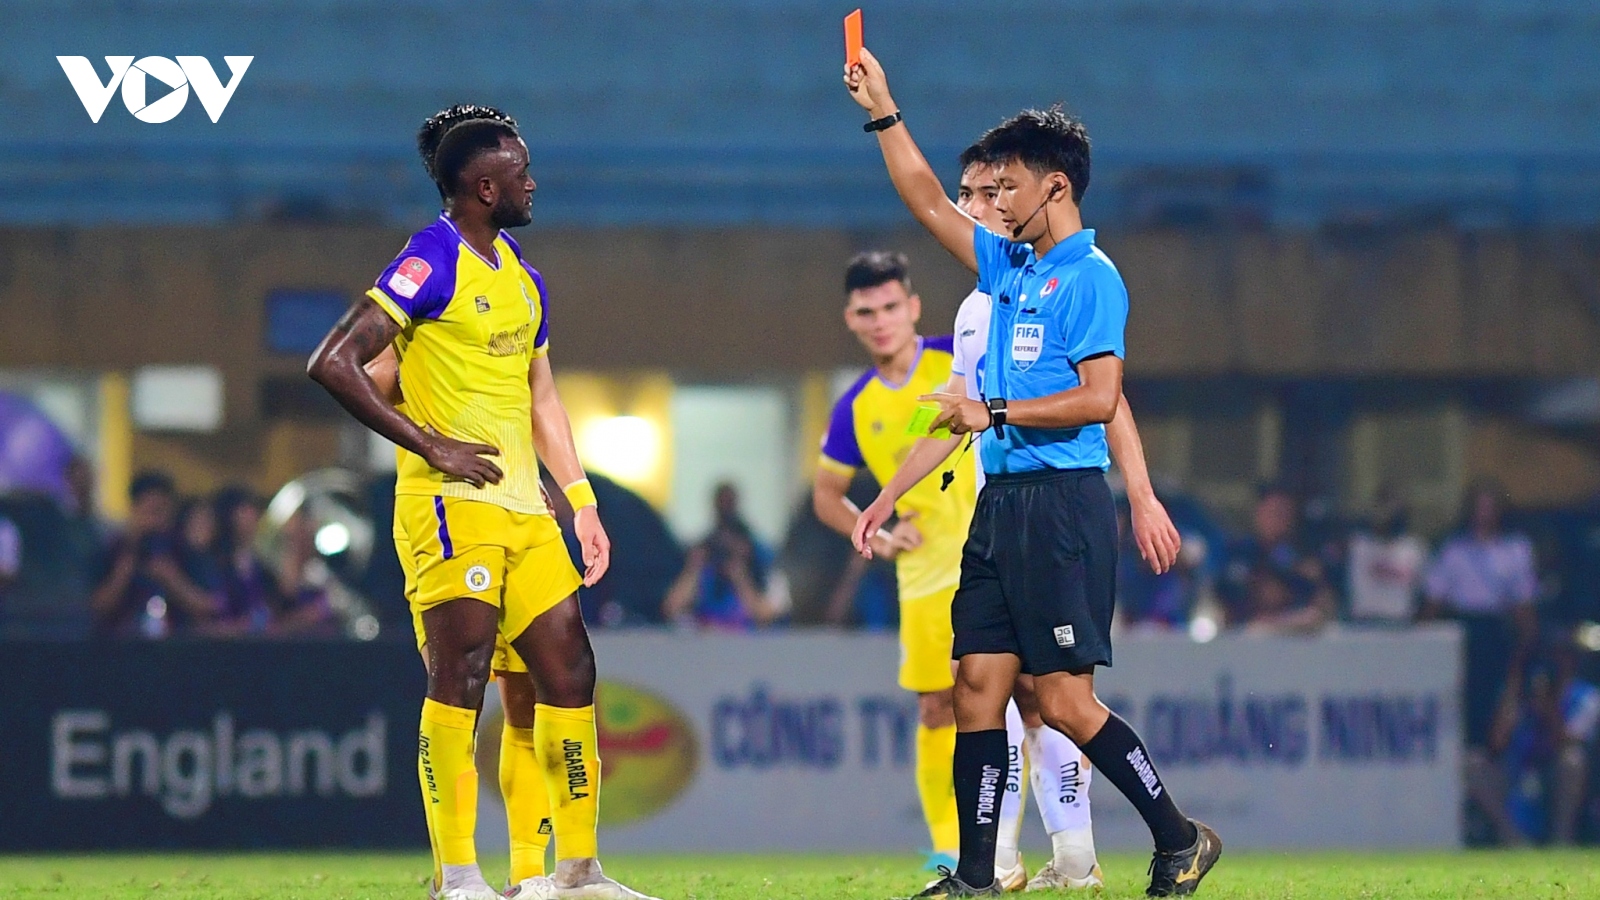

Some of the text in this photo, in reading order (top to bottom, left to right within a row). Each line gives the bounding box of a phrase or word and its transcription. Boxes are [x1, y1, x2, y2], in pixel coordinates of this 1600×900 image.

[1016, 327, 1040, 338] FIFA
[53, 709, 388, 820] England
[562, 738, 590, 801] JOGARBOLA
[1006, 745, 1021, 793] mitre
[1059, 761, 1084, 804] mitre
[1126, 746, 1163, 800] JOGARBOLA
[976, 764, 1002, 825] JOGARBOLA
